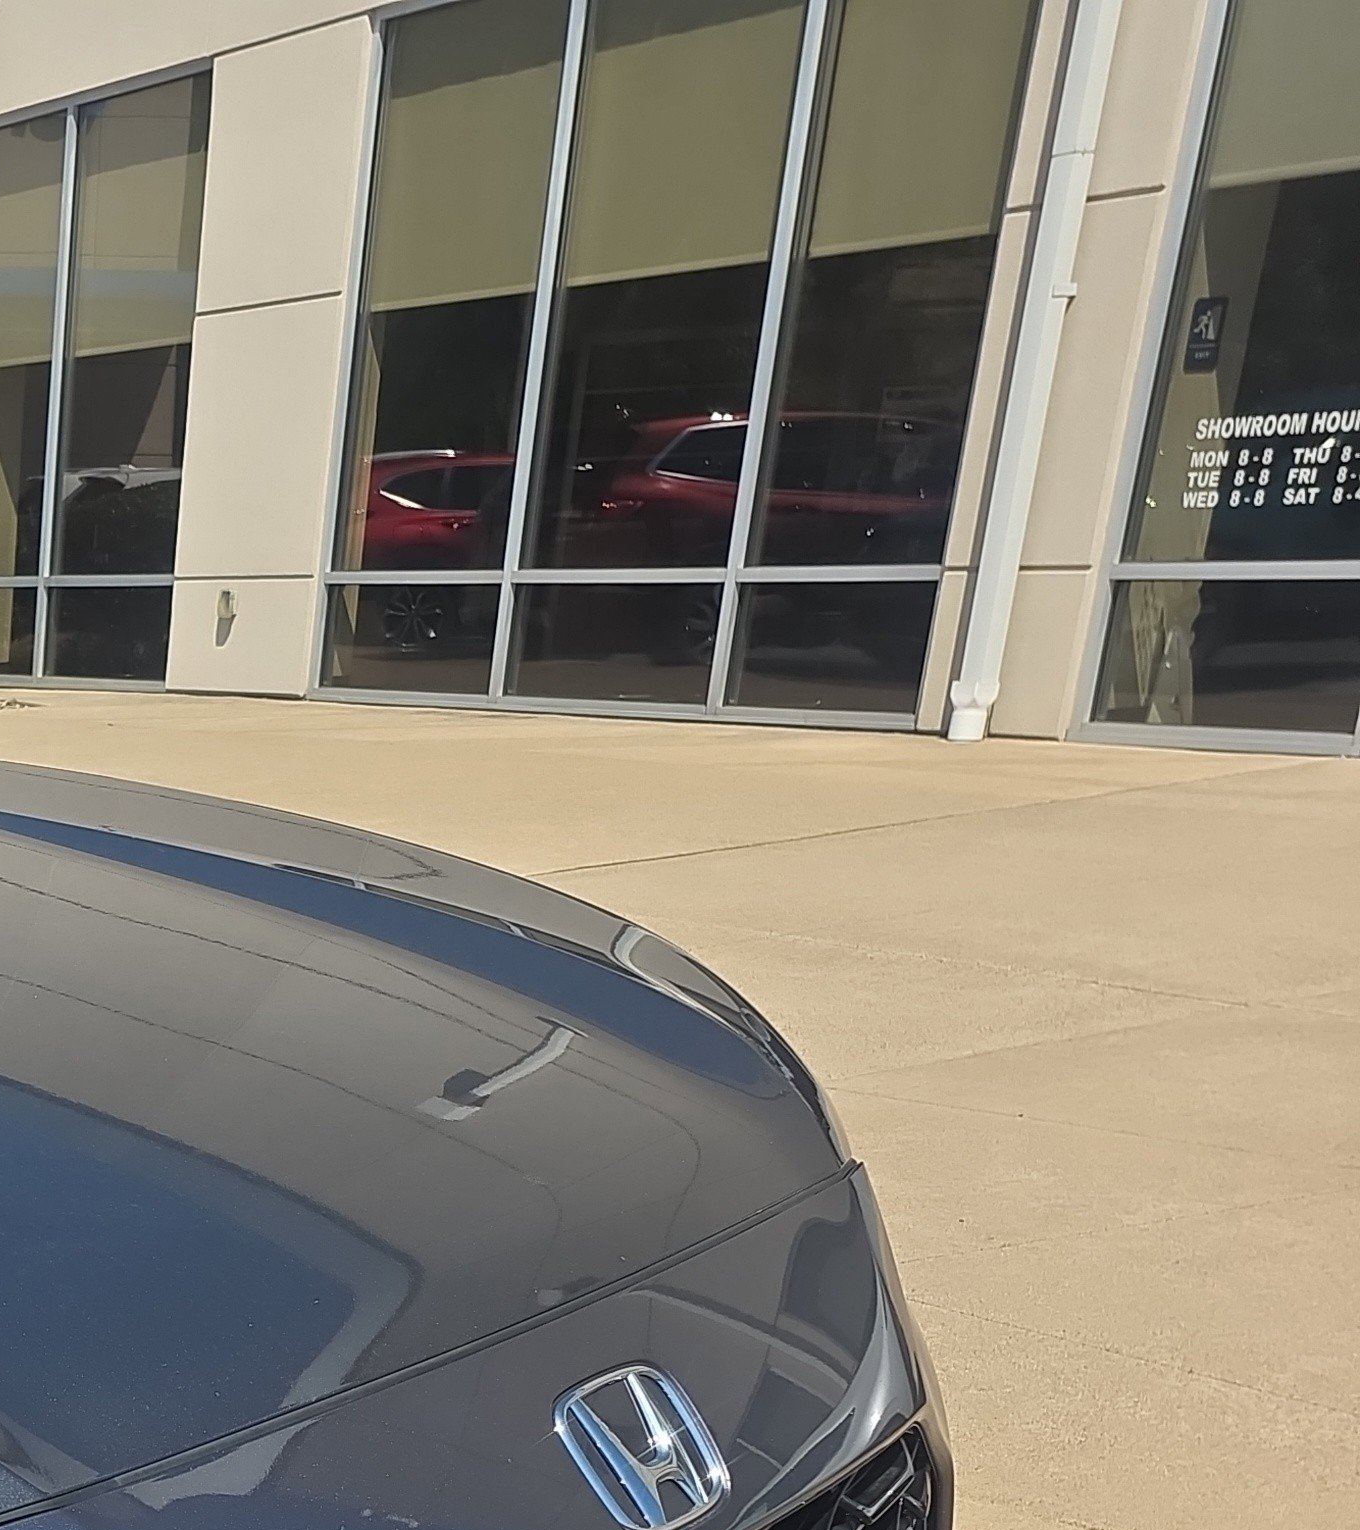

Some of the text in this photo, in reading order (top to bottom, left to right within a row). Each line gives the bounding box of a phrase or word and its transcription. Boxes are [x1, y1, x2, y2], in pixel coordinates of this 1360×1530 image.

[1195, 412, 1308, 440] SHOWROOM
[1190, 450, 1229, 467] MON
[1293, 447, 1331, 465] THU
[1187, 470, 1221, 488] TUE
[1287, 467, 1318, 485] FRI
[1182, 491, 1219, 508] WED
[1282, 487, 1321, 505] SAT
